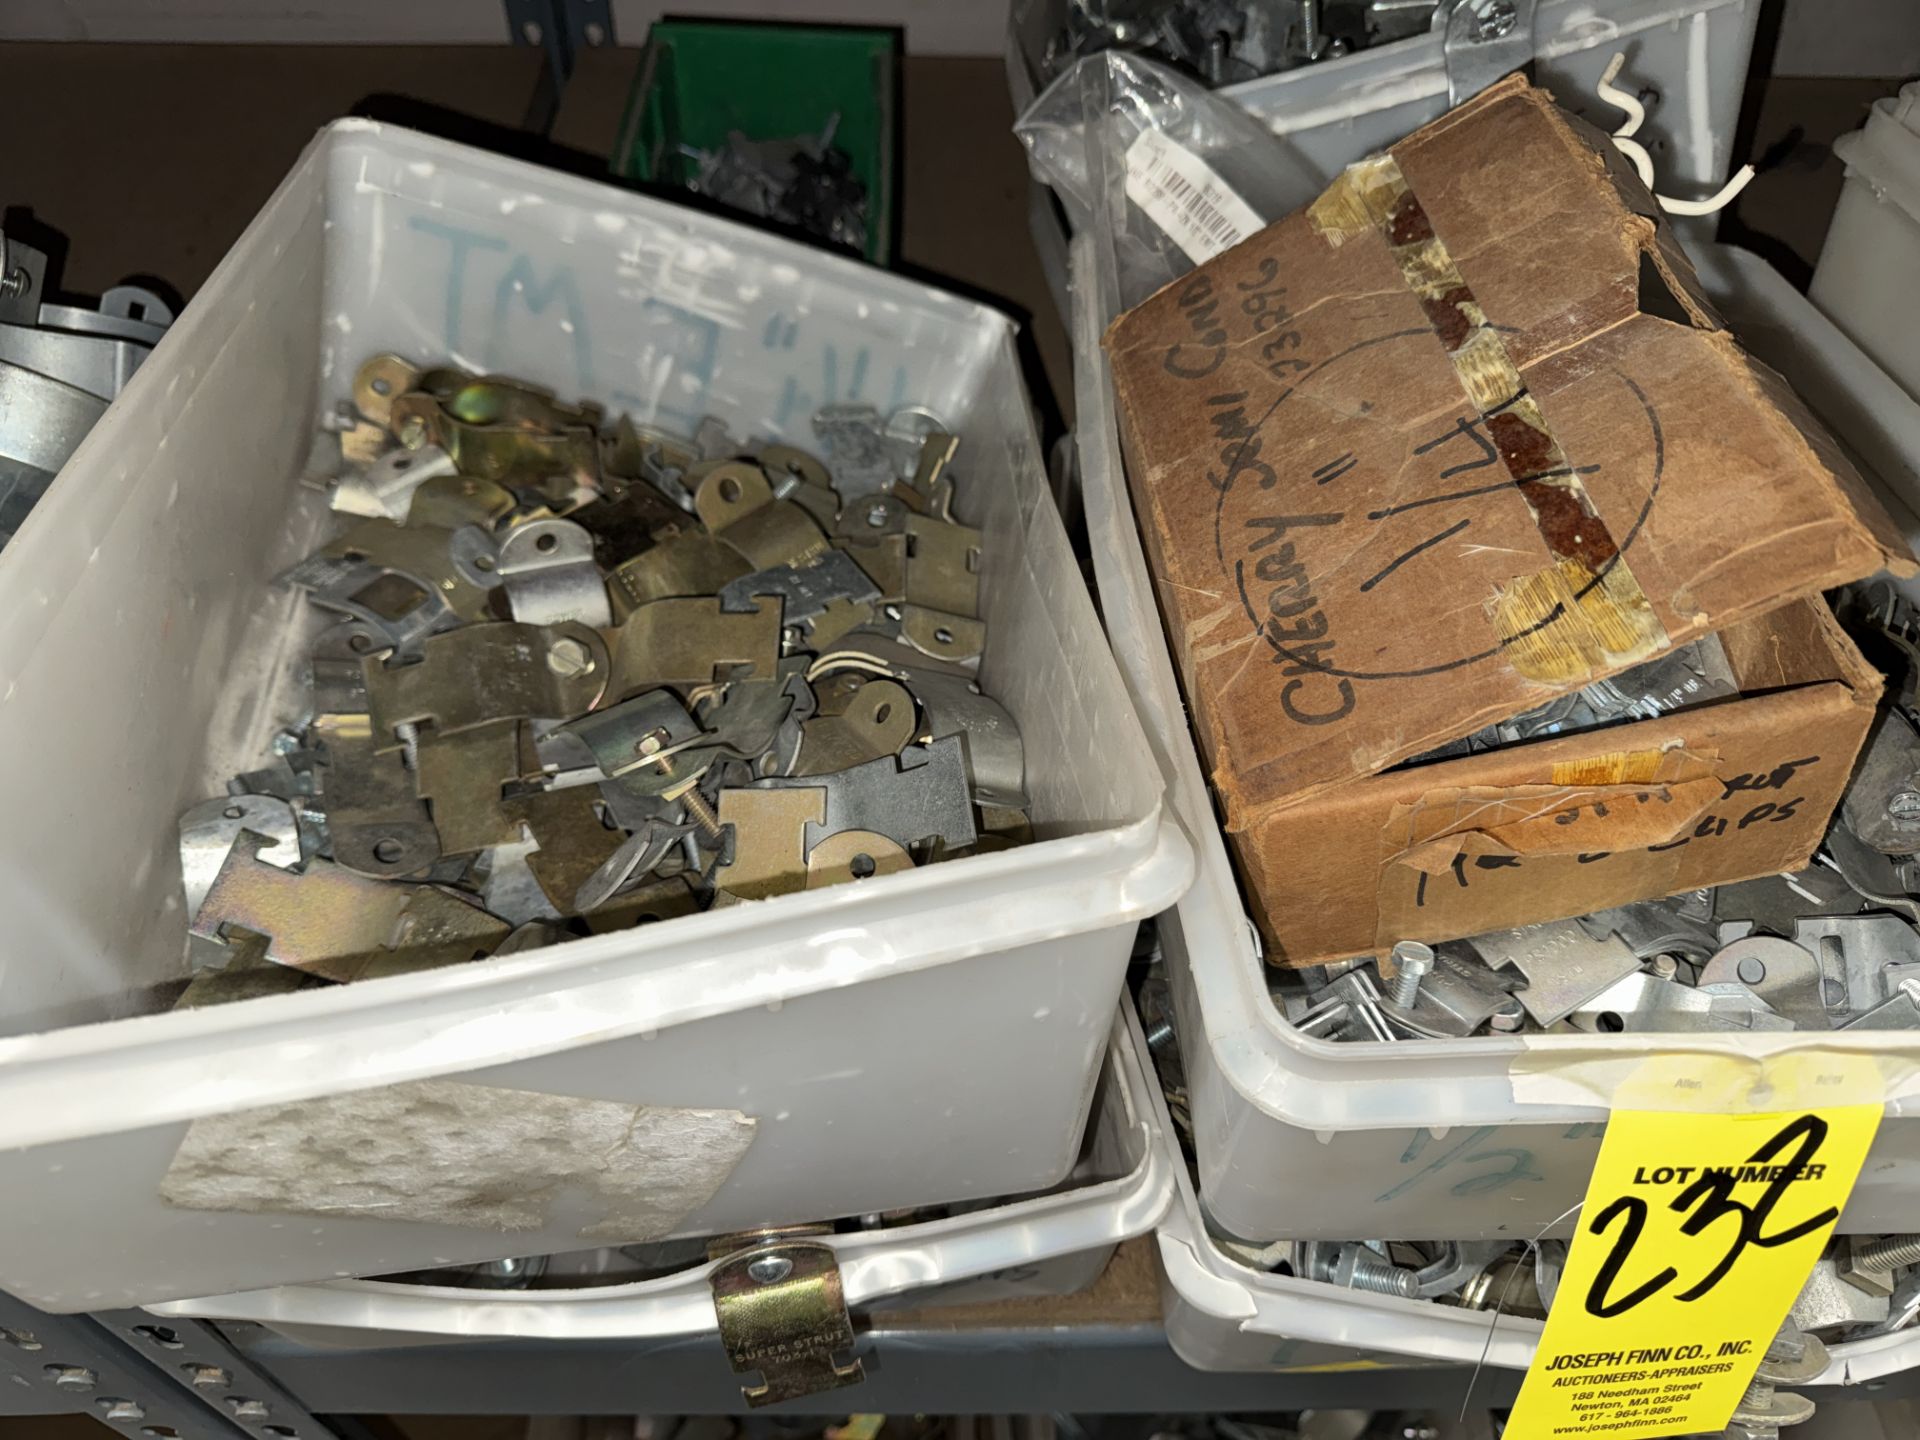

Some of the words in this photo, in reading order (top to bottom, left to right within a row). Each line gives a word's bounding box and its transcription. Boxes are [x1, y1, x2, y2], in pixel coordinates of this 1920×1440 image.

[1246, 511, 1357, 725] CHERRY
[1633, 1167, 1696, 1185] LOT
[1584, 1113, 1839, 1319] 232
[735, 1343, 787, 1363] SUPER
[793, 1330, 844, 1349] STRUT
[1545, 1350, 1625, 1371] JOSEPH
[1625, 1346, 1674, 1365] FINN
[1673, 1344, 1711, 1361] CO.,
[1716, 1340, 1753, 1357] INC.
[1551, 1361, 1734, 1387] AUCTIONEERS-APPRAISERS
[1570, 1401, 1624, 1412] Newton,
[1628, 1397, 1650, 1407] MA
[1653, 1392, 1691, 1404] 02464
[1571, 1391, 1595, 1401] 188
[1597, 1386, 1660, 1399] Needham
[1663, 1381, 1703, 1393] Street
[1553, 1414, 1688, 1435] www.josephfinn.com
[1579, 1411, 1604, 1422] 617
